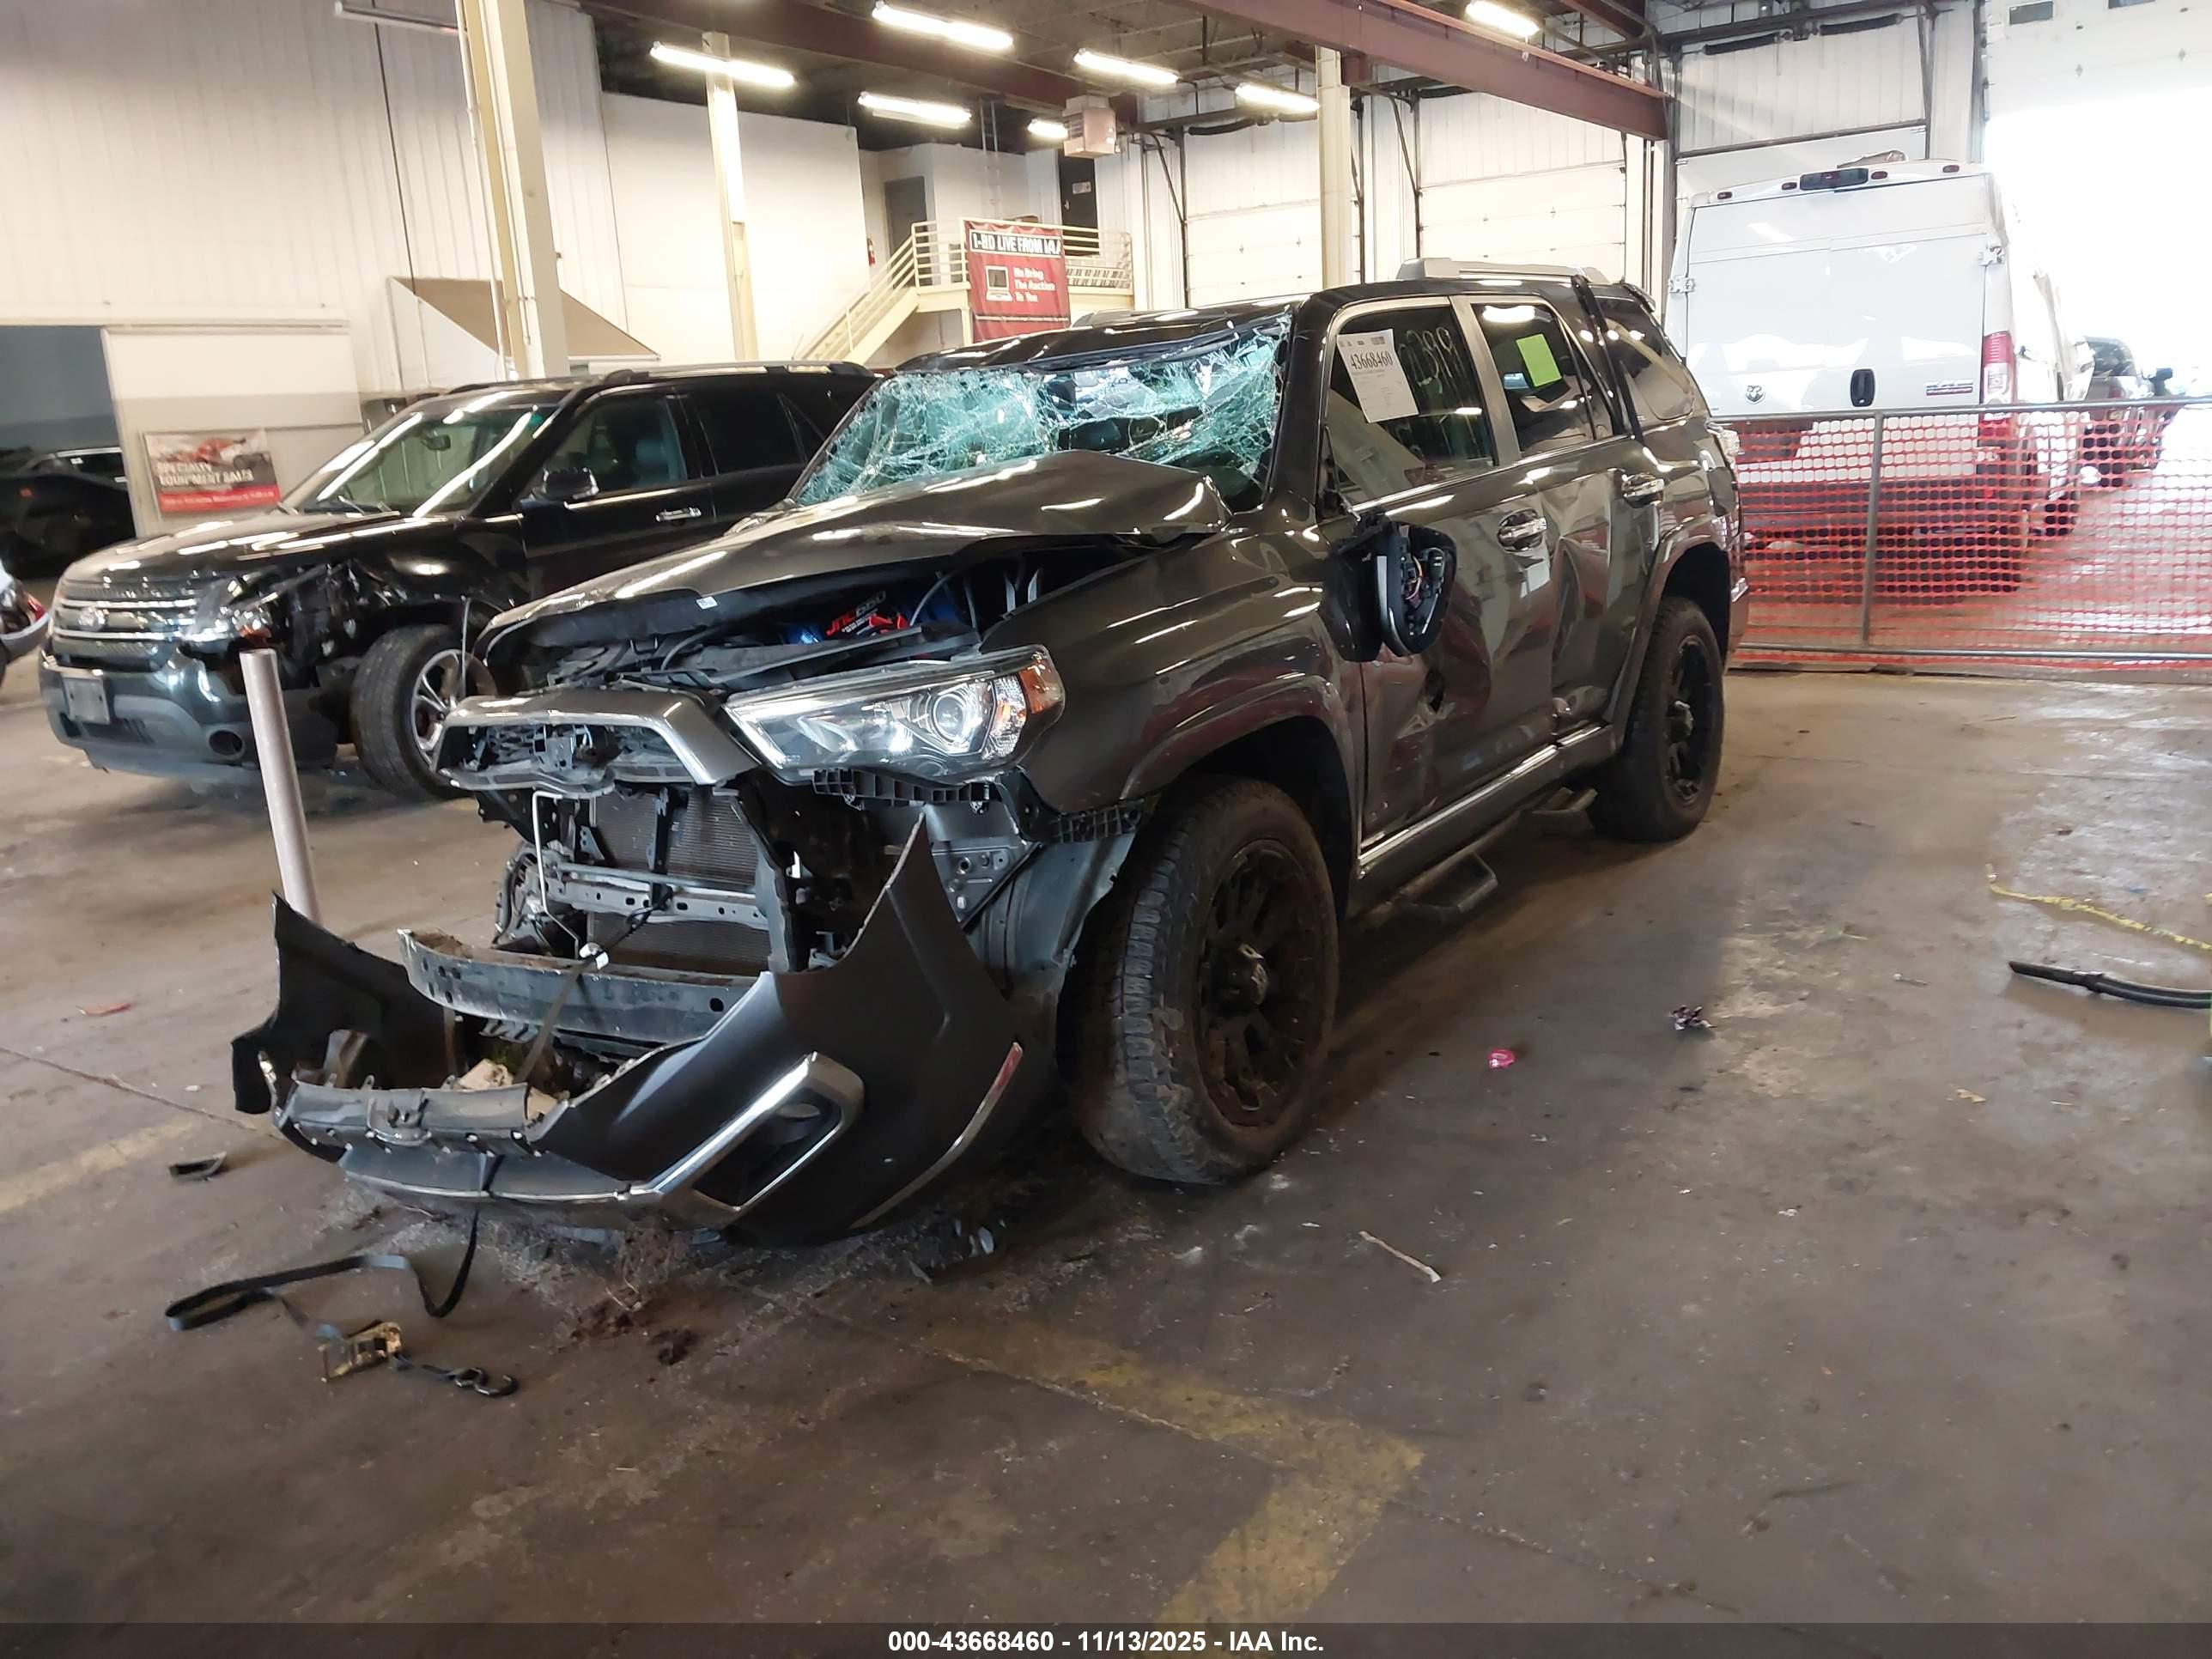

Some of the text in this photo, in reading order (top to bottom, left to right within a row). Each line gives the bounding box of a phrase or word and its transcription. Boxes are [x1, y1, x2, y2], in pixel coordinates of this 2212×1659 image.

[997, 235, 1017, 252] LIVE
[1018, 237, 1043, 253] FROM
[1350, 349, 1393, 370] 43668460
